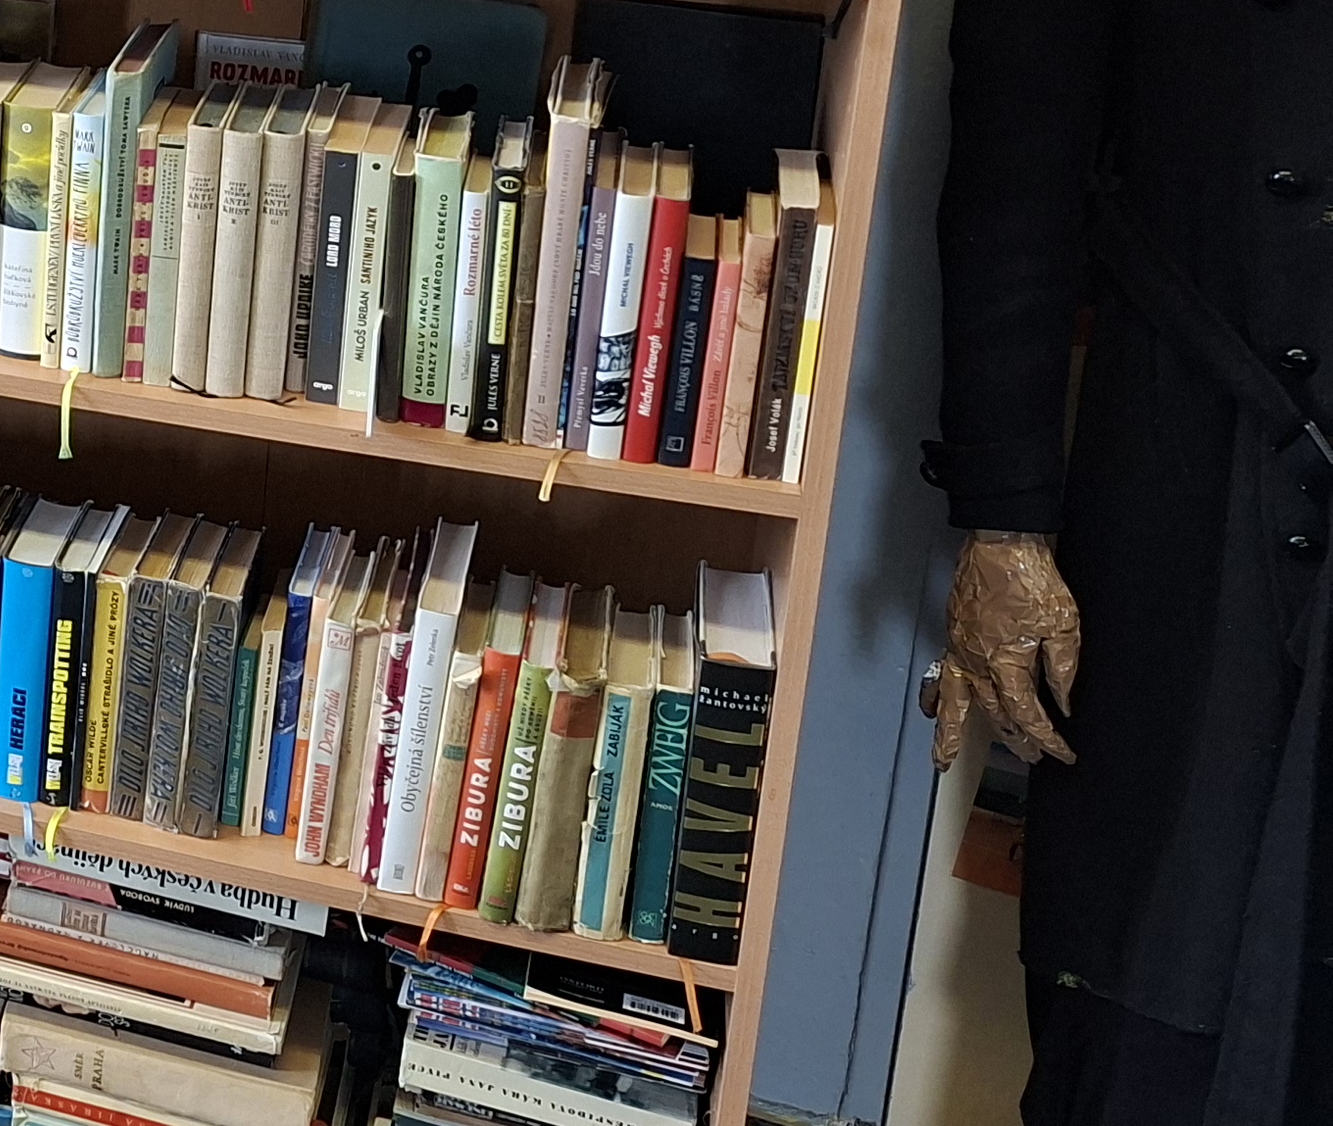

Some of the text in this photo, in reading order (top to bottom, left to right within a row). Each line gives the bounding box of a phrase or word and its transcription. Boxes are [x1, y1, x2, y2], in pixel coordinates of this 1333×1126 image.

[361, 208, 378, 284] SANTINIHO JAZYK
[434, 256, 443, 301] NÁRODA
[355, 290, 369, 362] MILOŠ URBAN
[414, 276, 431, 394] VLADISLAV VANČURA
[431, 307, 439, 338] DĚJIN
[425, 356, 435, 396] OBRAZY
[48, 619, 73, 753] TRAINSPOTTING
[700, 686, 768, 703] michael
[9, 688, 26, 750] HERACI
[605, 705, 624, 759] ZABIJÁK
[648, 701, 690, 793] ZWEIG
[300, 763, 332, 858] JOHN WYNDHAM
[399, 752, 423, 813] Obyčejná
[460, 756, 490, 848] ZIBURA
[498, 746, 537, 851] ZIBURA
[598, 771, 614, 804] ZOLA
[675, 723, 765, 920] HAVEL
[200, 877, 215, 895] v
[221, 883, 298, 921] Hudba
